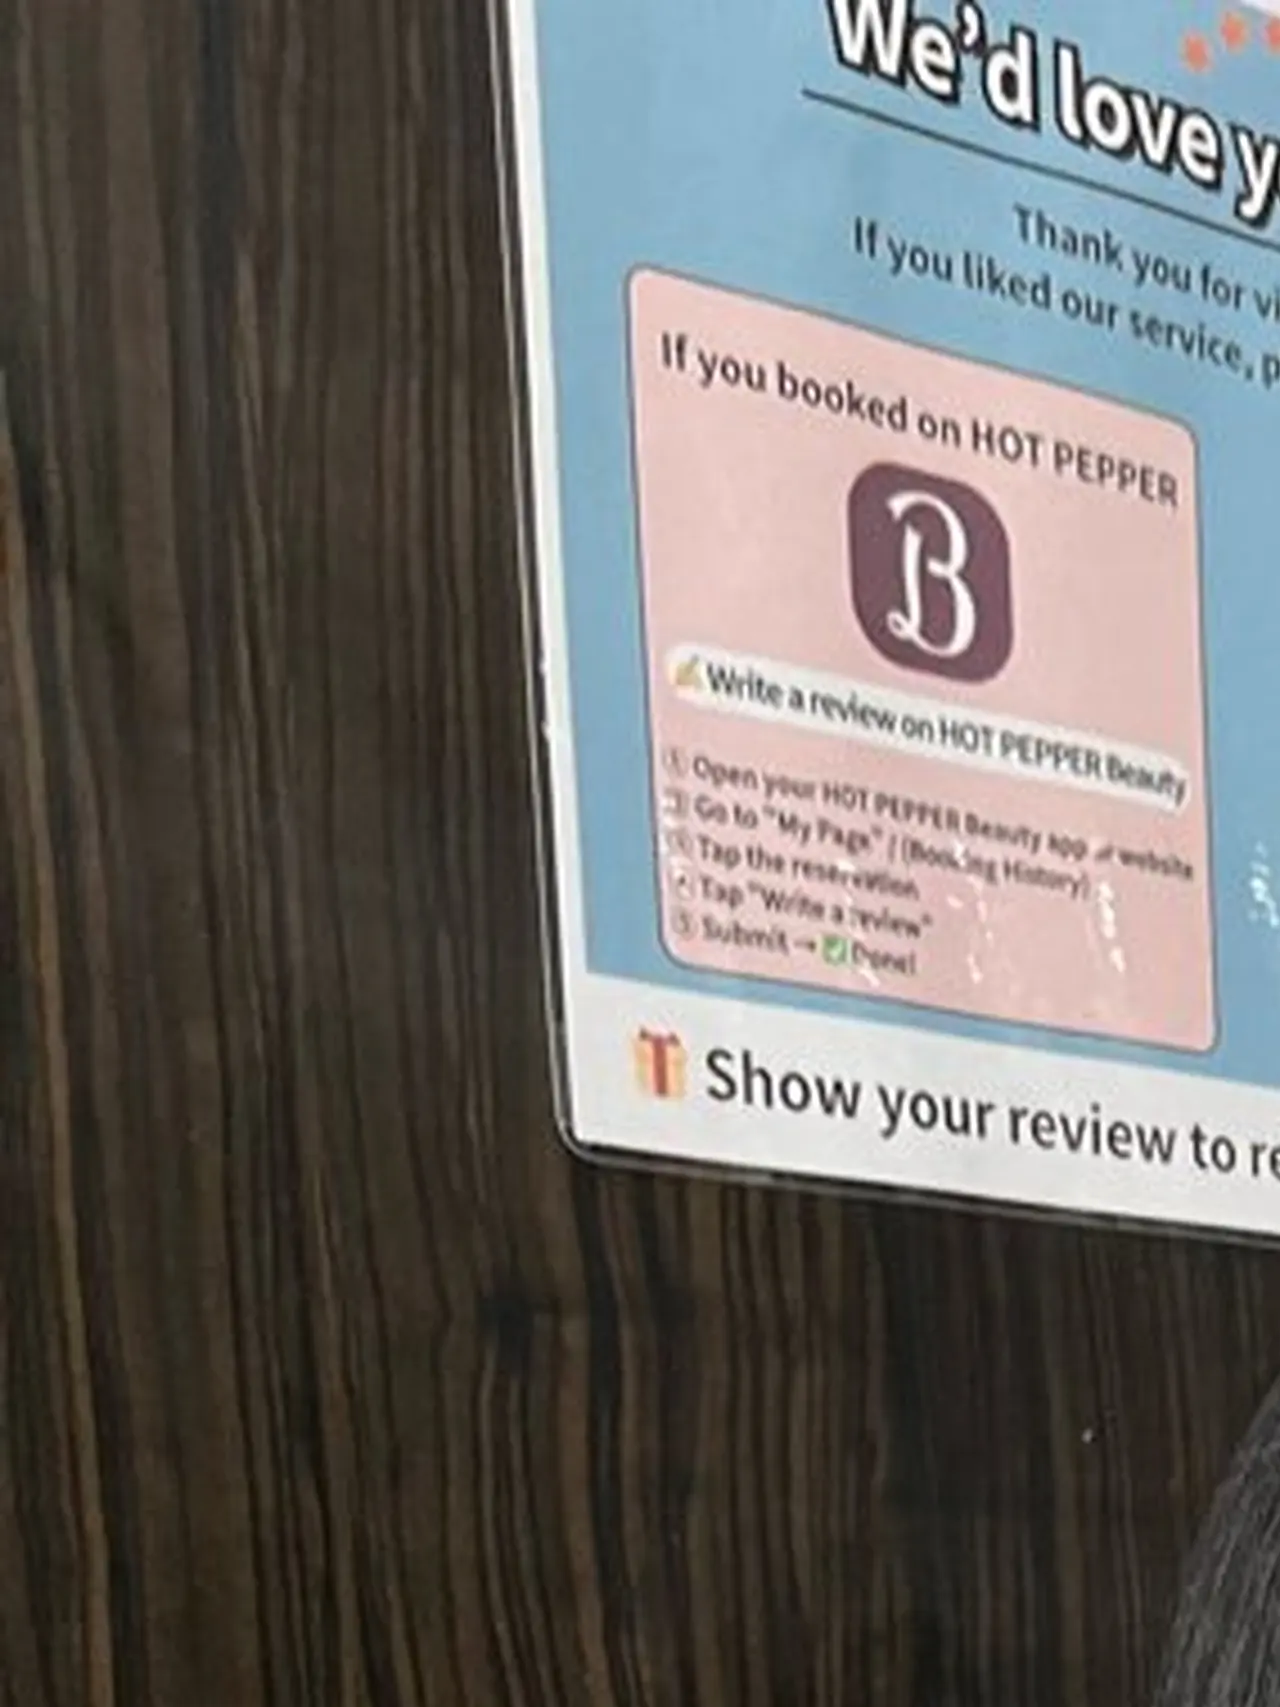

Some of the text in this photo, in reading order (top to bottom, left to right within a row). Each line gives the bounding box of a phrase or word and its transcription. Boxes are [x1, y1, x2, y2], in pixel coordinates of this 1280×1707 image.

[826, 0, 1040, 132] We'd
[1052, 38, 1223, 192] love
[853, 217, 877, 259] If
[887, 240, 953, 282] you
[963, 254, 1051, 309] liked
[1062, 288, 1119, 330] our
[1129, 305, 1256, 382] service,
[1013, 203, 1124, 272] Thank
[1133, 248, 1191, 295] you
[1200, 263, 1246, 310] for
[661, 332, 1180, 508] If you booked on HOT PEPPER
[693, 754, 758, 792] Open
[822, 781, 868, 812] HOT
[874, 792, 960, 831] PEPPER
[705, 661, 1186, 806] Write a review on HOT PEPPER Beauty
[746, 843, 786, 873] the
[706, 1047, 861, 1120] Show
[878, 1080, 996, 1141] your
[1010, 1102, 1177, 1166] review
[1191, 1122, 1236, 1174] to
